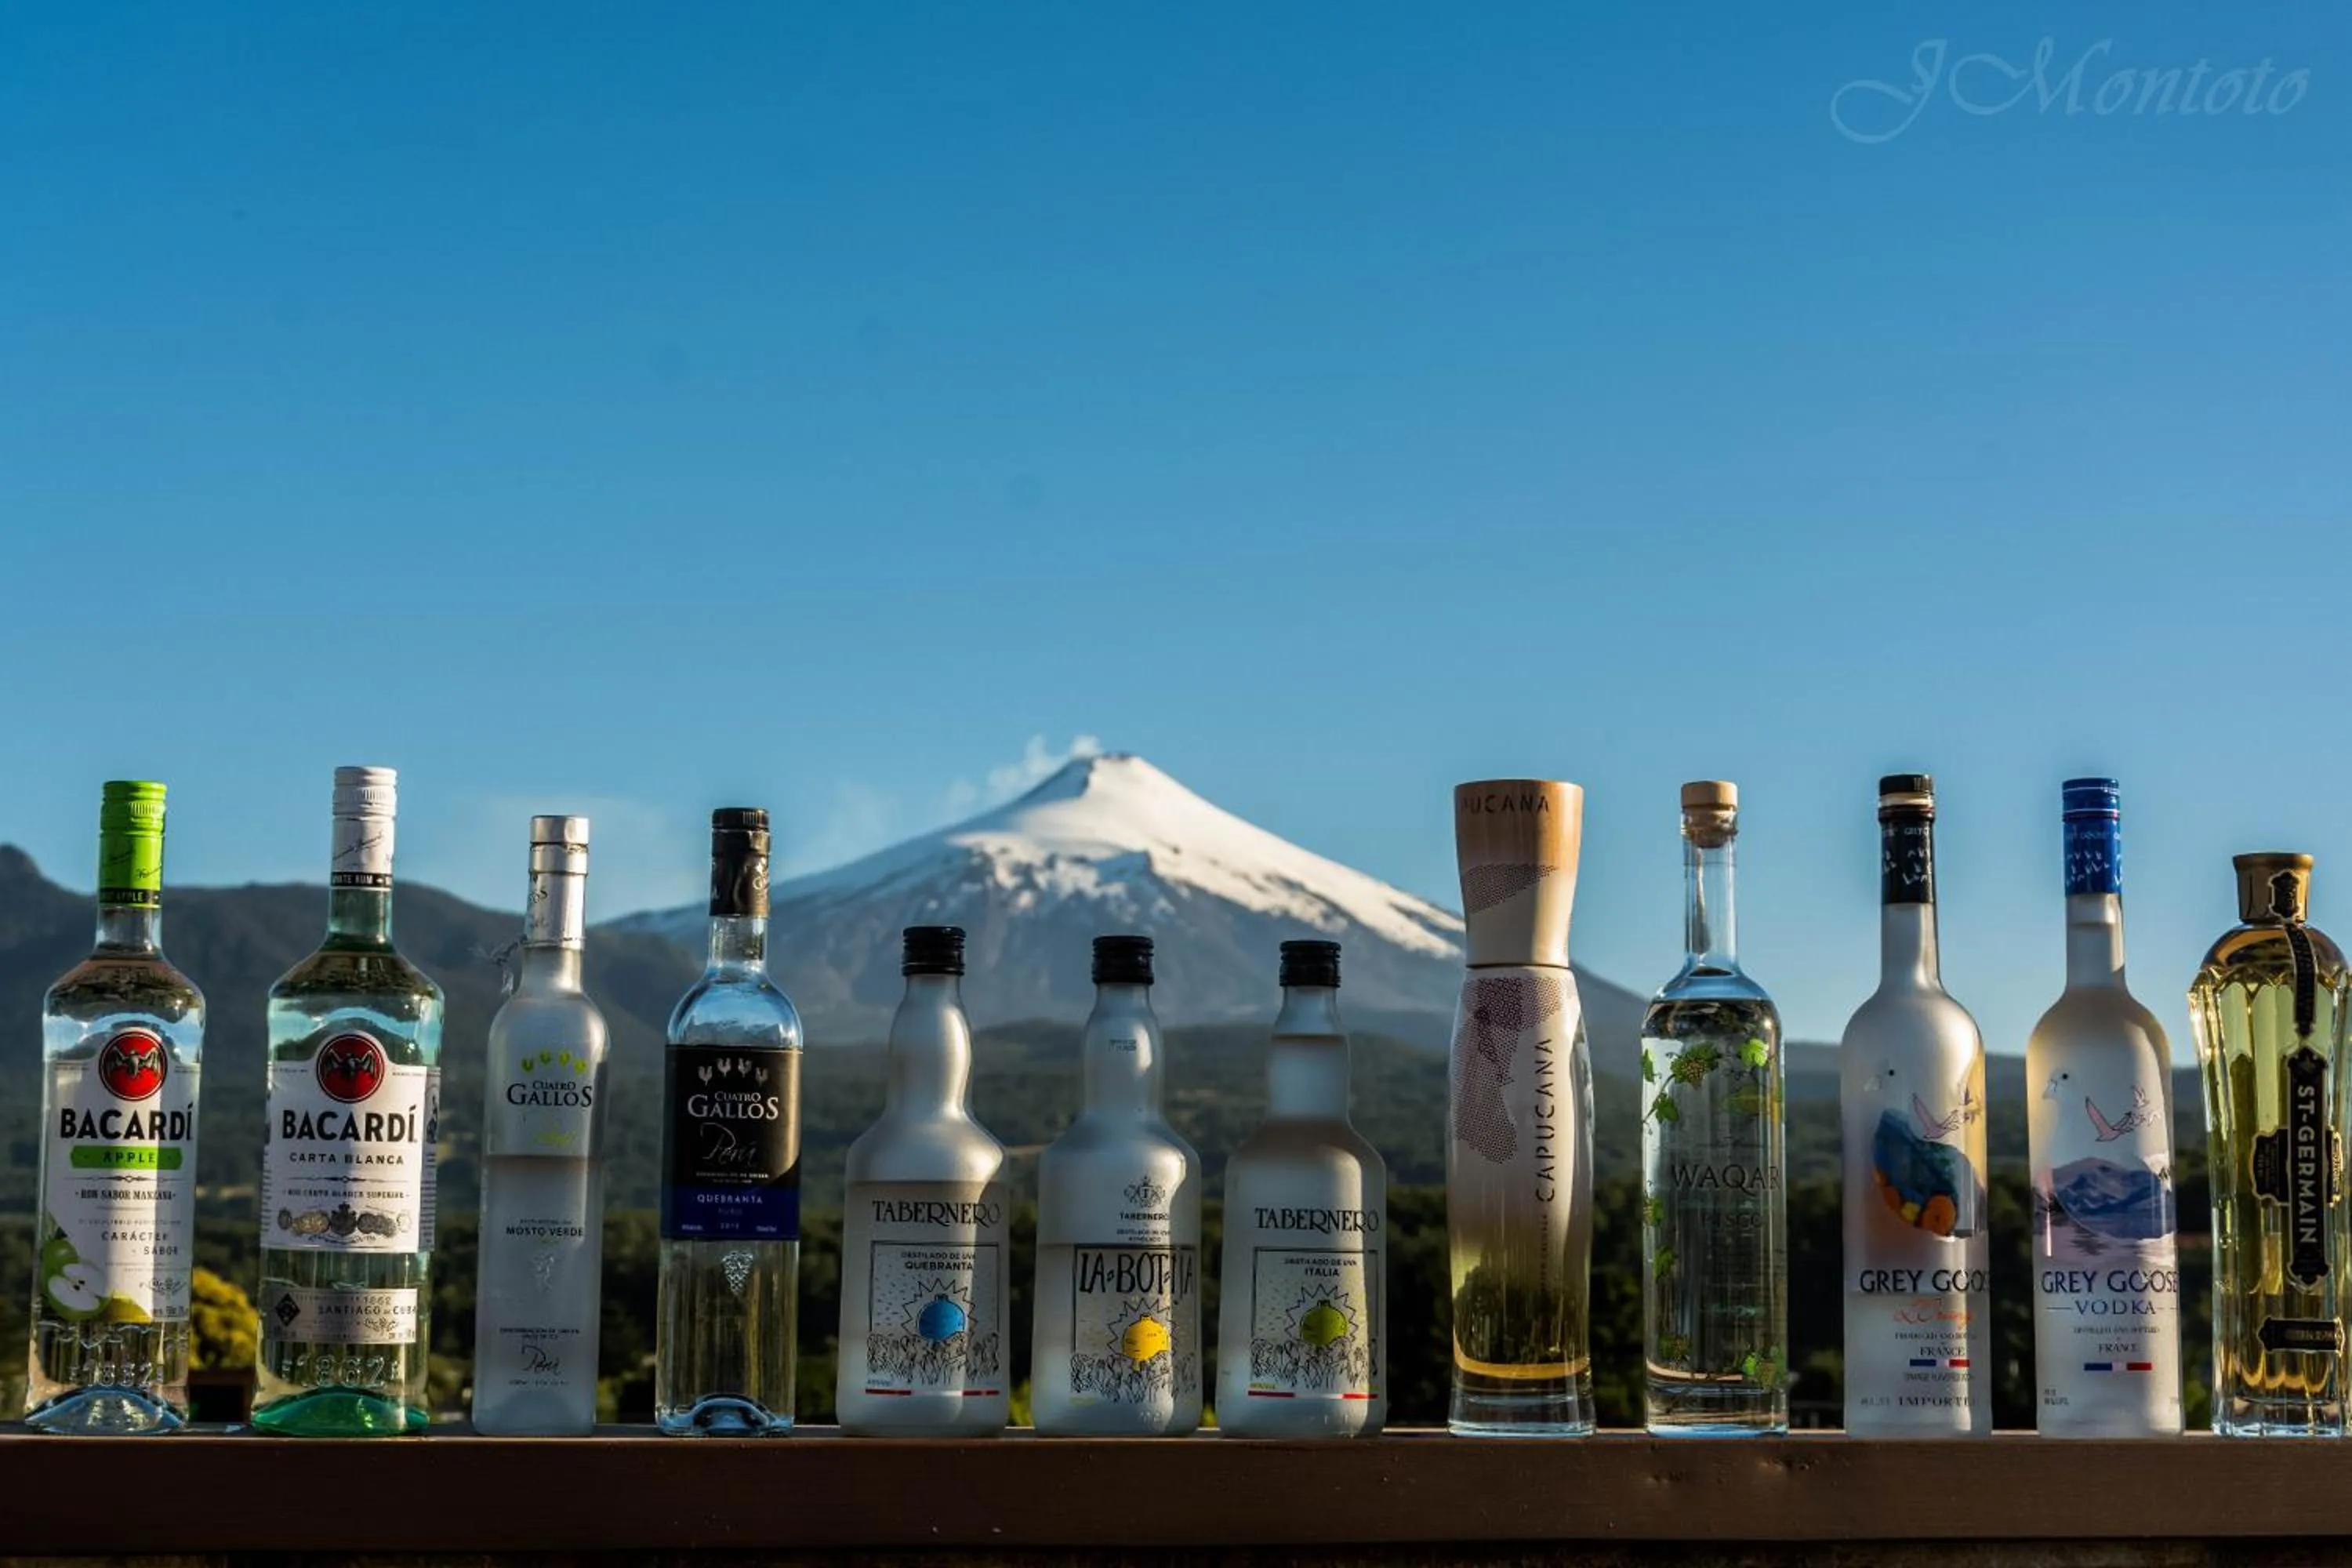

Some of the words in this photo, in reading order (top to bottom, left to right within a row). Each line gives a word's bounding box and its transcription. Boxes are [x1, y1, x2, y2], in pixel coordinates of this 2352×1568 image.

[506, 1083, 592, 1107] GALLOS
[532, 1080, 576, 1091] CUATRO
[714, 1091, 761, 1102] CUATRO
[688, 1094, 779, 1120] GALLOS
[60, 1102, 194, 1141] BACARDÍ
[282, 1105, 417, 1142] BACARDÍ
[1535, 1038, 1555, 1202] CAPUCANA
[103, 1152, 156, 1163] APPLE
[289, 1152, 336, 1163] CARTA
[344, 1154, 404, 1164] BLANCA
[2297, 1084, 2318, 1243] ST-GERMAIN
[1671, 1163, 1780, 1197] WAQAR
[697, 1193, 763, 1204] QUEBRANTA
[872, 1200, 1001, 1227] TABERNERO
[1254, 1207, 1379, 1235] TABERNERO
[506, 1226, 546, 1236] MOSTO
[549, 1227, 583, 1237] VERDE
[905, 1261, 974, 1271] QUEBRANTA
[1305, 1268, 1340, 1277] ITALIA
[1860, 1269, 1924, 1293] GREY
[1932, 1269, 1989, 1293] GOO
[2042, 1270, 2097, 1293] GREY
[318, 1305, 380, 1315] SANTIAGO
[2075, 1299, 2157, 1316] VODKA
